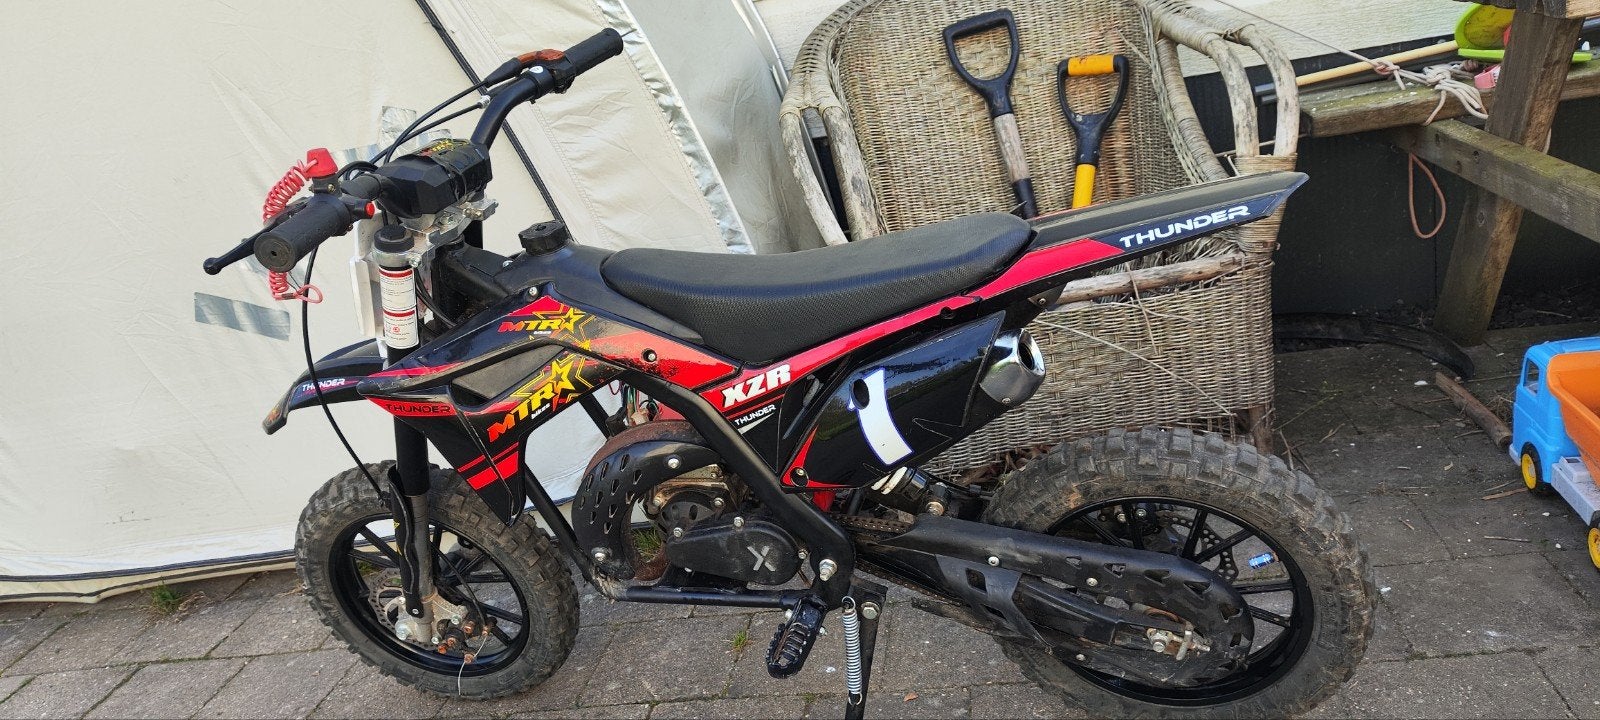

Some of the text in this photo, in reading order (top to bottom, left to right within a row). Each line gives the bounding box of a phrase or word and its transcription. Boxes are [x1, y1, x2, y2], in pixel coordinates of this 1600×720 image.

[1119, 206, 1251, 247] THUNDER
[498, 319, 561, 332] MTR
[302, 378, 346, 391] THNDER
[723, 364, 791, 408] XZR
[386, 403, 451, 413] THUNDER
[487, 381, 556, 443] MTR
[734, 404, 777, 426] THUNDER
